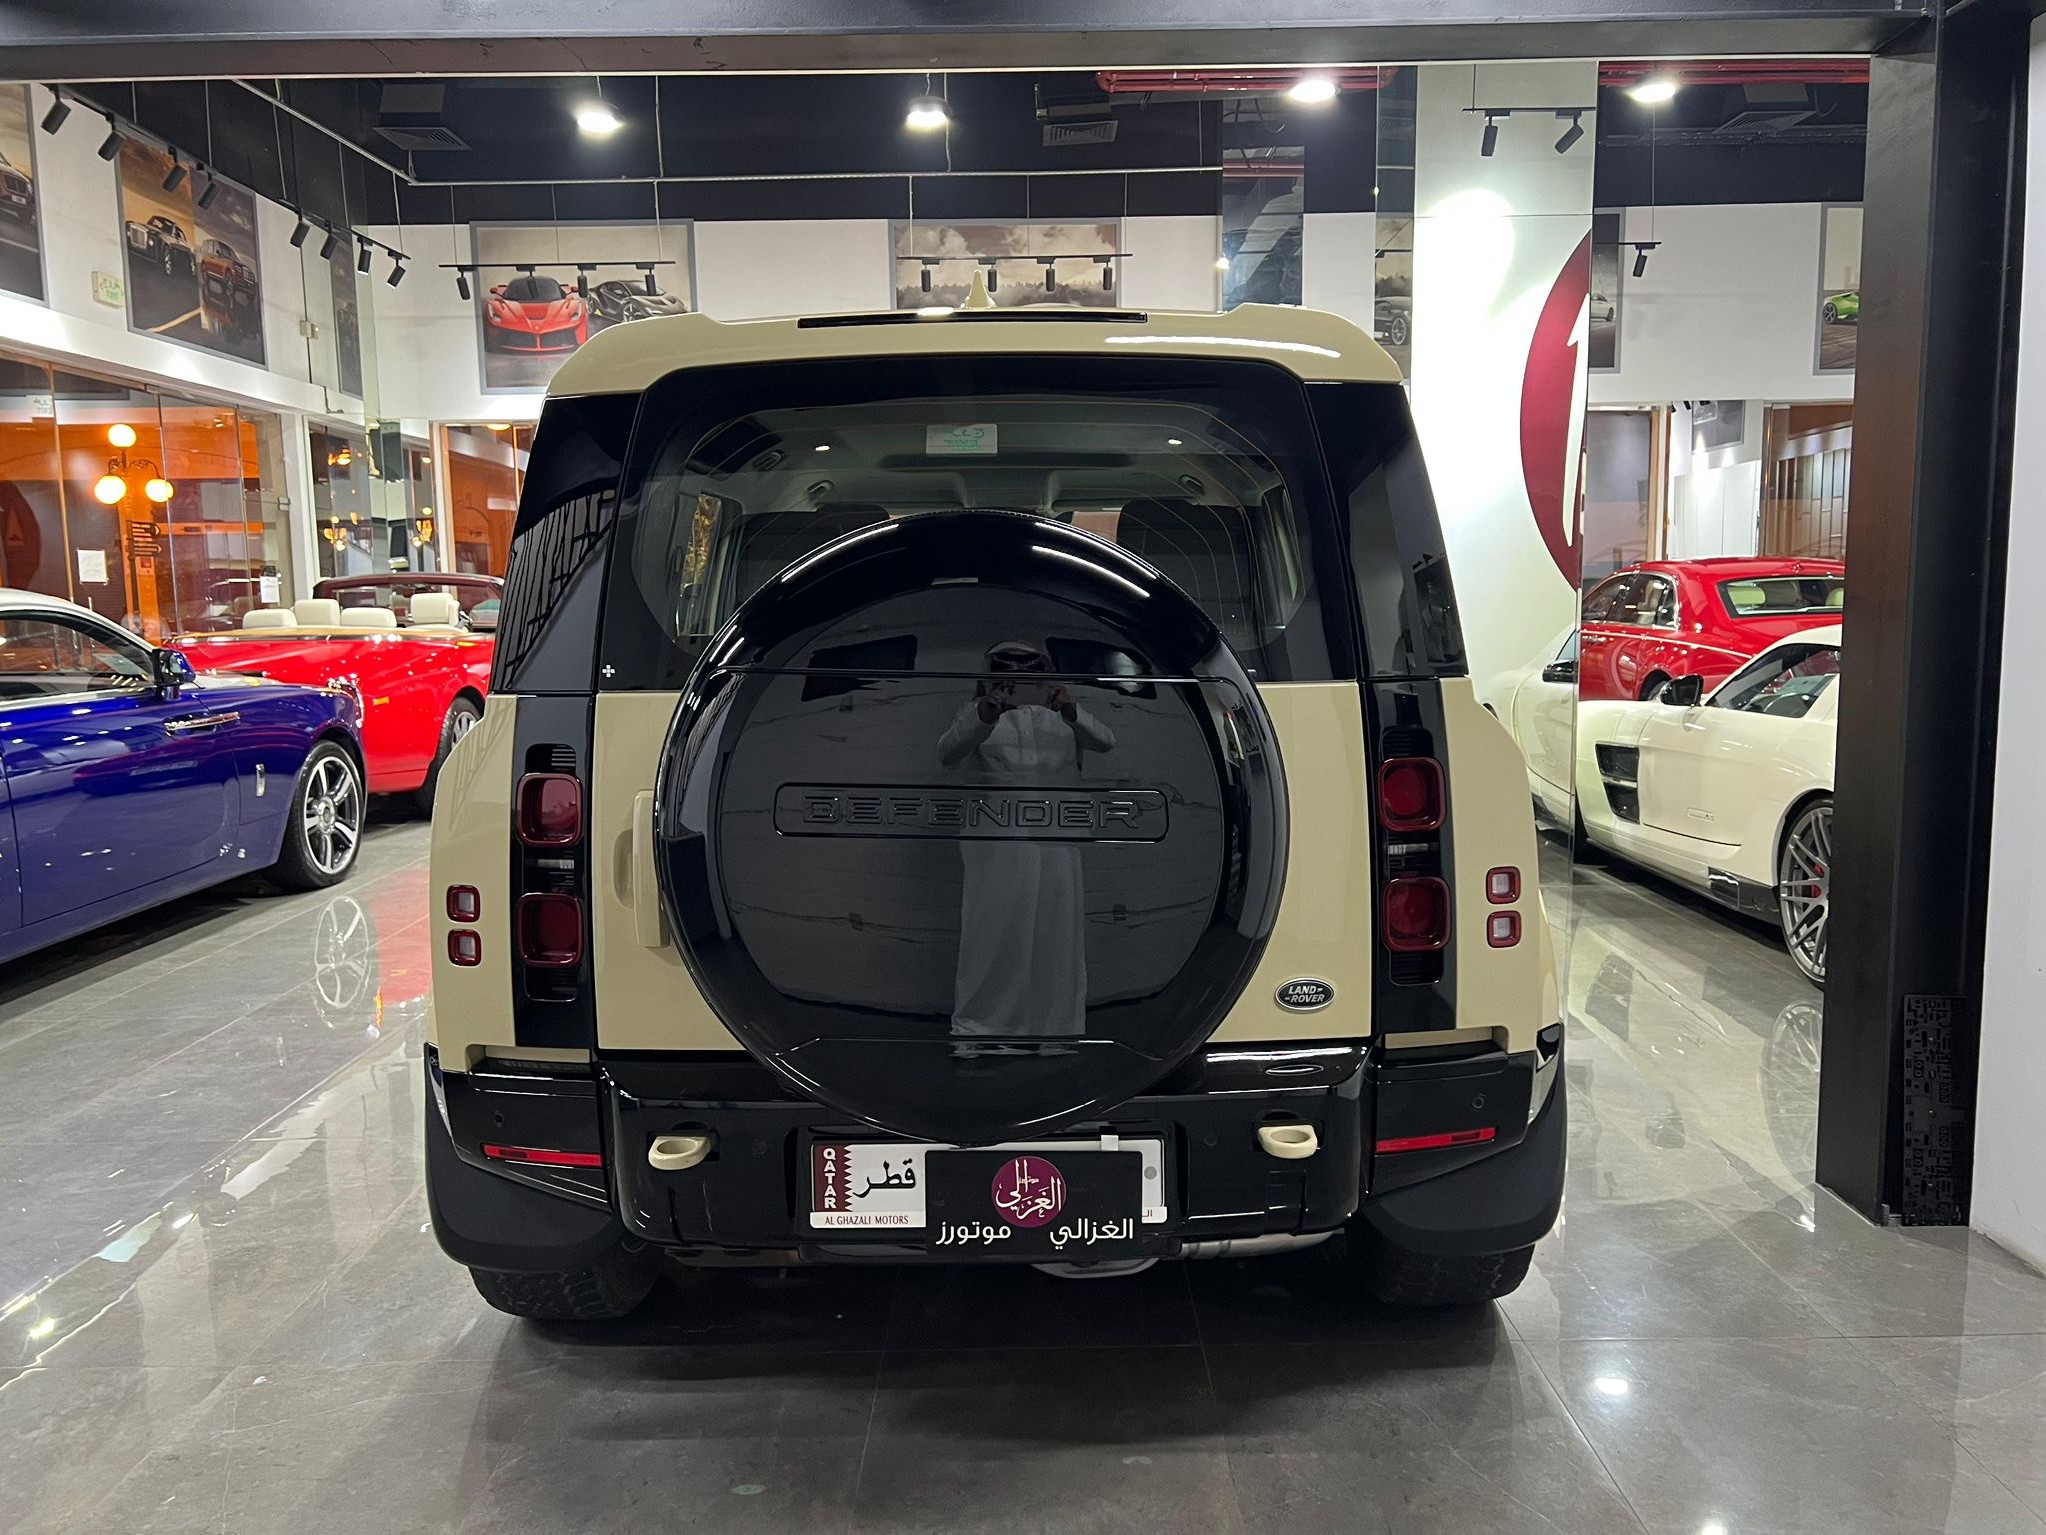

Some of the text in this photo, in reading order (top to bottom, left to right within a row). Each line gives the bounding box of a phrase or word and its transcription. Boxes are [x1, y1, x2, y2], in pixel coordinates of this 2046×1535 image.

[803, 796, 1139, 829] DEFENDER
[1288, 985, 1317, 995] LAND
[1290, 994, 1325, 1003] ROVER
[823, 1148, 837, 1209] QATAR
[852, 1158, 916, 1198] قطر
[824, 1215, 909, 1226] AL GHAZALI MOTORS
[935, 1218, 1134, 1250] الغزالي موتورز
